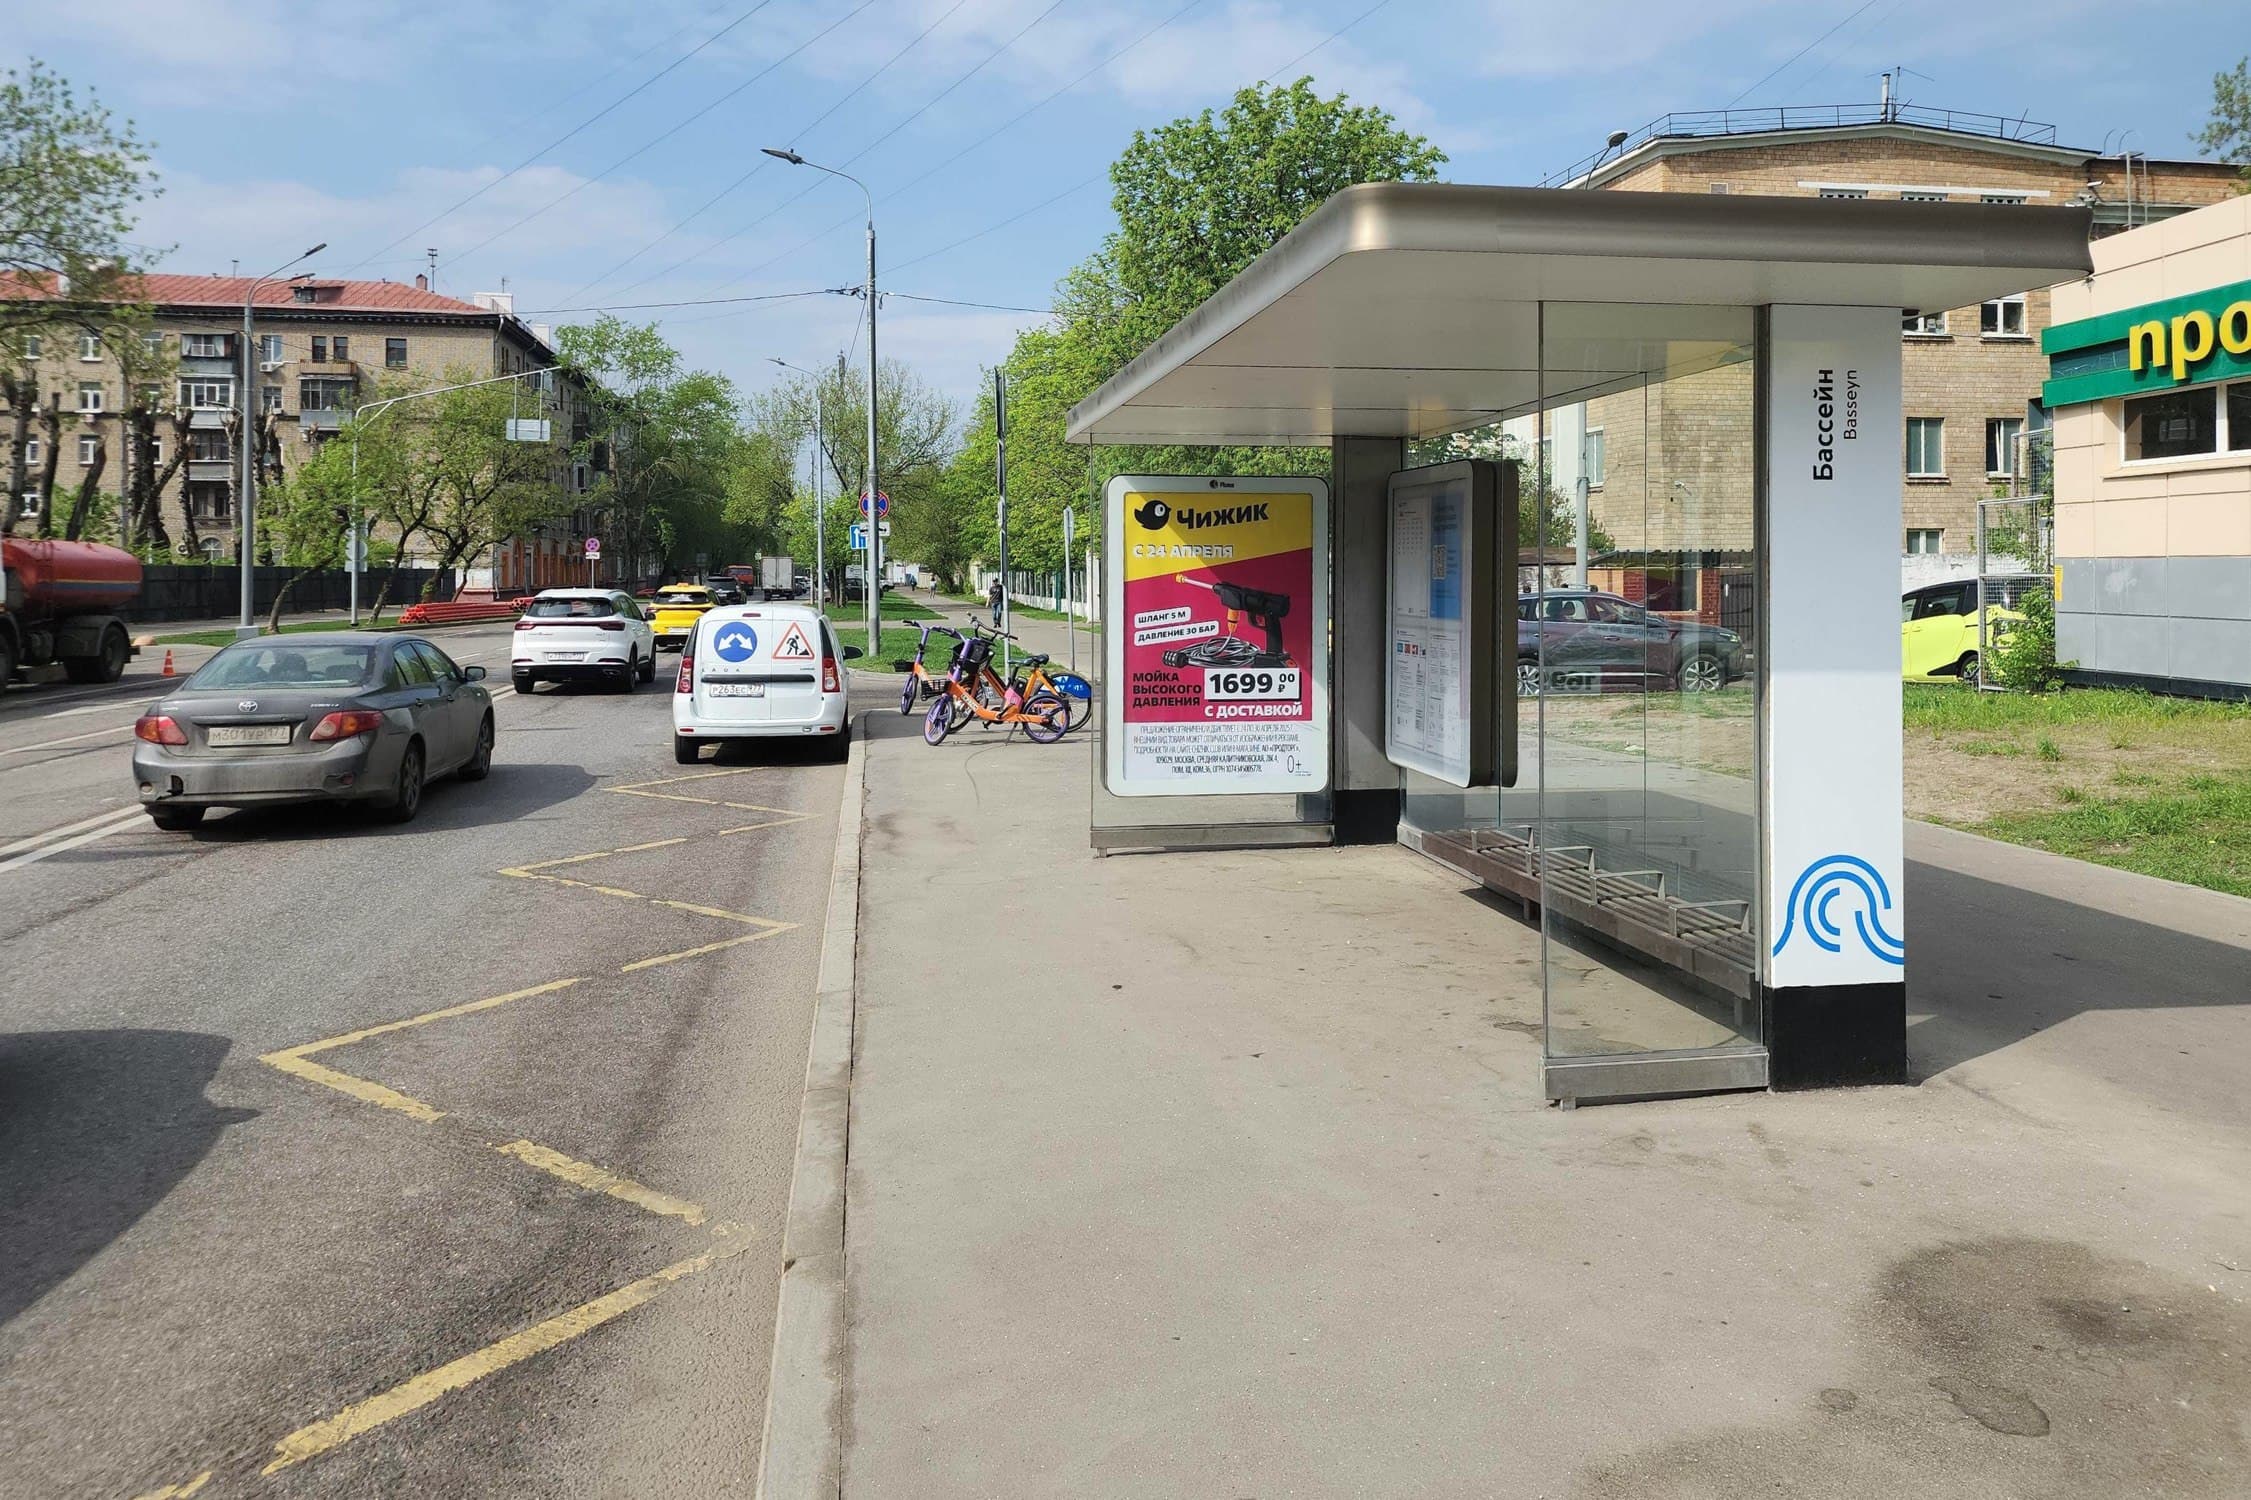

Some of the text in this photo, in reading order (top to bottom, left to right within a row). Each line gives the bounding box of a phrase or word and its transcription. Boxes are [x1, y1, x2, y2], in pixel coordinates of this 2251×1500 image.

[1844, 370, 1860, 439] Basseyn
[1813, 369, 1833, 480] Бассейн
[1133, 544, 1234, 559] С 24 АПРЕЛЯ
[1138, 612, 1169, 624] ШЛАНГ
[1178, 611, 1186, 619] М
[1138, 624, 1216, 642] ДАВЛЕНИЕ 30 БАР
[1133, 670, 1179, 682] МОЙКА
[1209, 673, 1295, 694] 1699 00
[1132, 684, 1201, 695] ВЫСОКОГО
[1132, 697, 1200, 709] ДАВЛЕНИЯ
[1204, 702, 1302, 719] С ДОСТАВКОЙ
[1287, 755, 1301, 773] 0+
